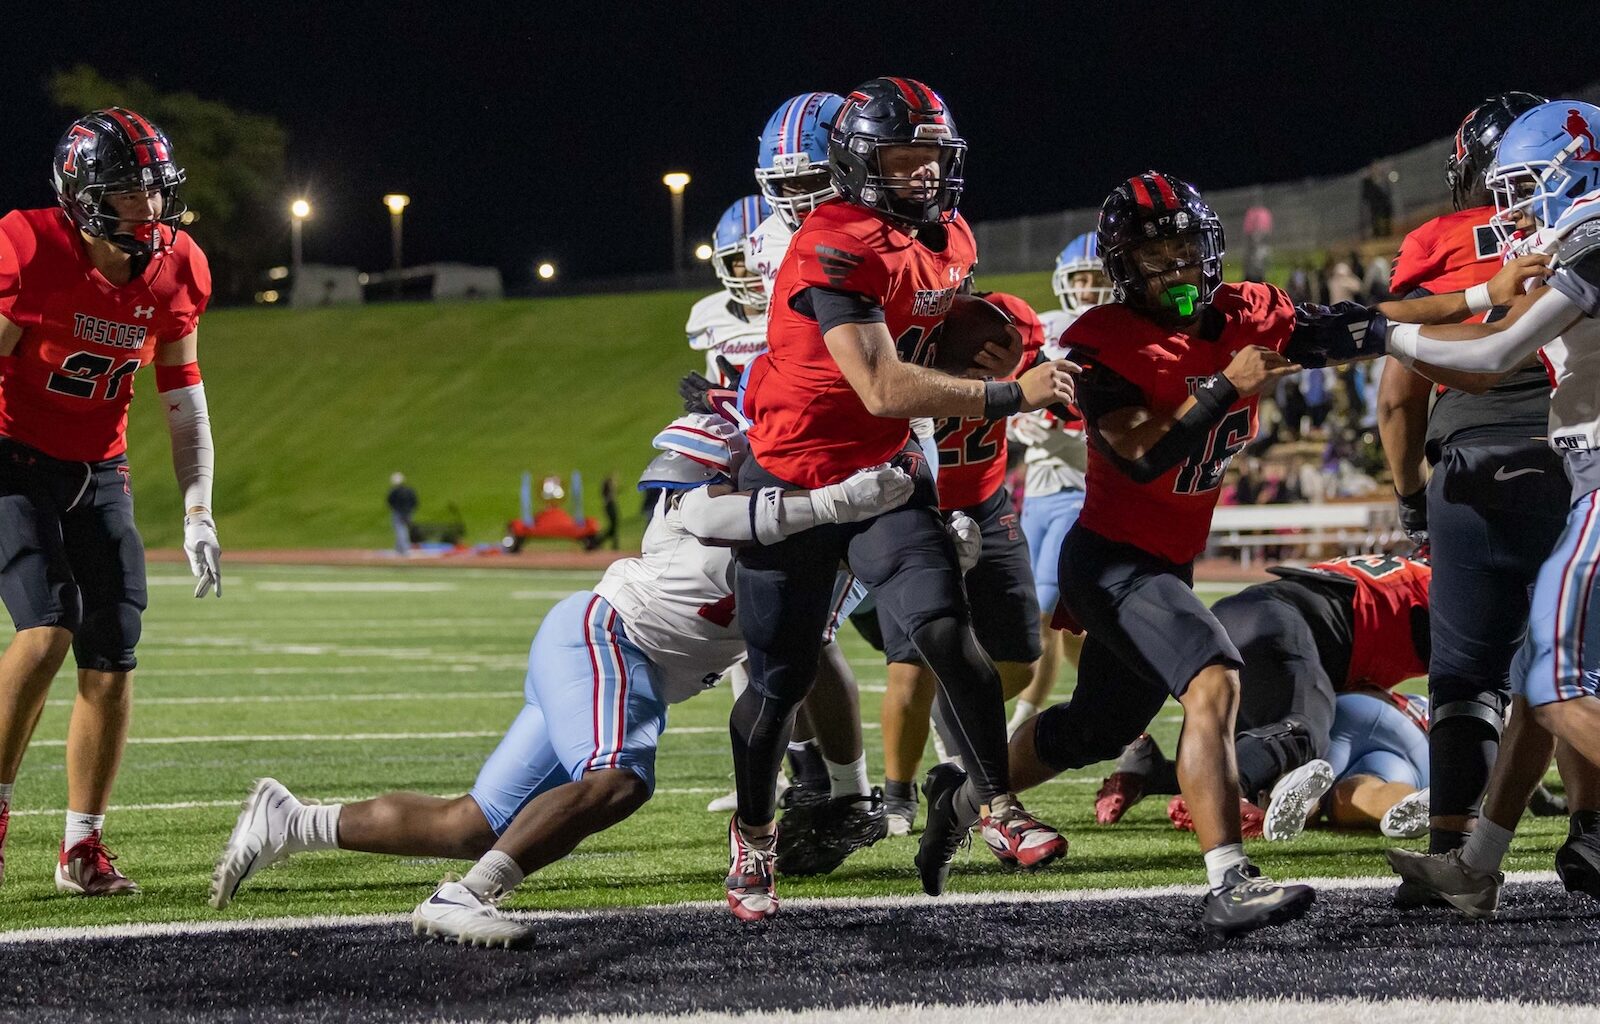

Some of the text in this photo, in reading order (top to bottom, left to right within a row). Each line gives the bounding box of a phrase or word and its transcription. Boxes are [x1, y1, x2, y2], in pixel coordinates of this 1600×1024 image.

[63, 124, 96, 178] T
[73, 313, 147, 349] TASCOSA
[46, 351, 142, 400] 21
